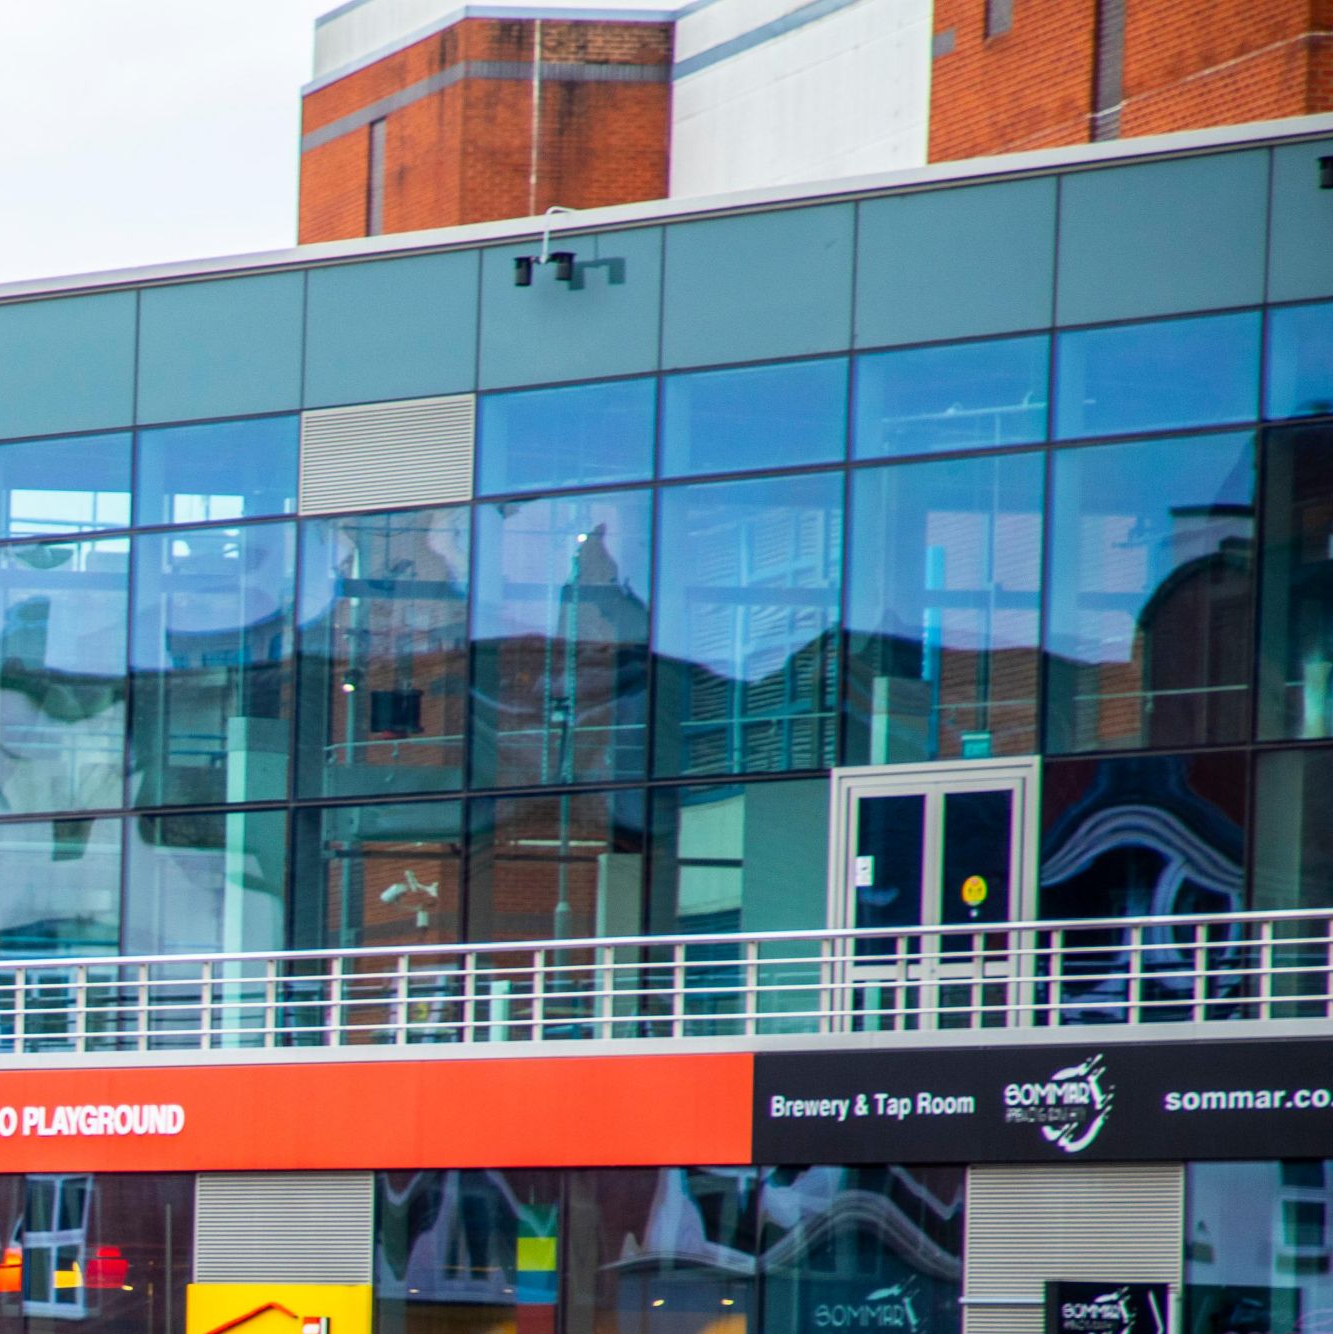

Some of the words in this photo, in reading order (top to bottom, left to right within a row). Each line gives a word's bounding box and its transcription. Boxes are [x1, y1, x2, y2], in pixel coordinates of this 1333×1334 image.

[770, 1095, 850, 1122] Brewery
[853, 1093, 870, 1116] &
[873, 1092, 912, 1121] Tap
[915, 1092, 976, 1115] Room
[1004, 1082, 1090, 1106] SOMMAR
[22, 1104, 185, 1137] PLAYGROUND
[814, 1304, 906, 1328] SOMMAR
